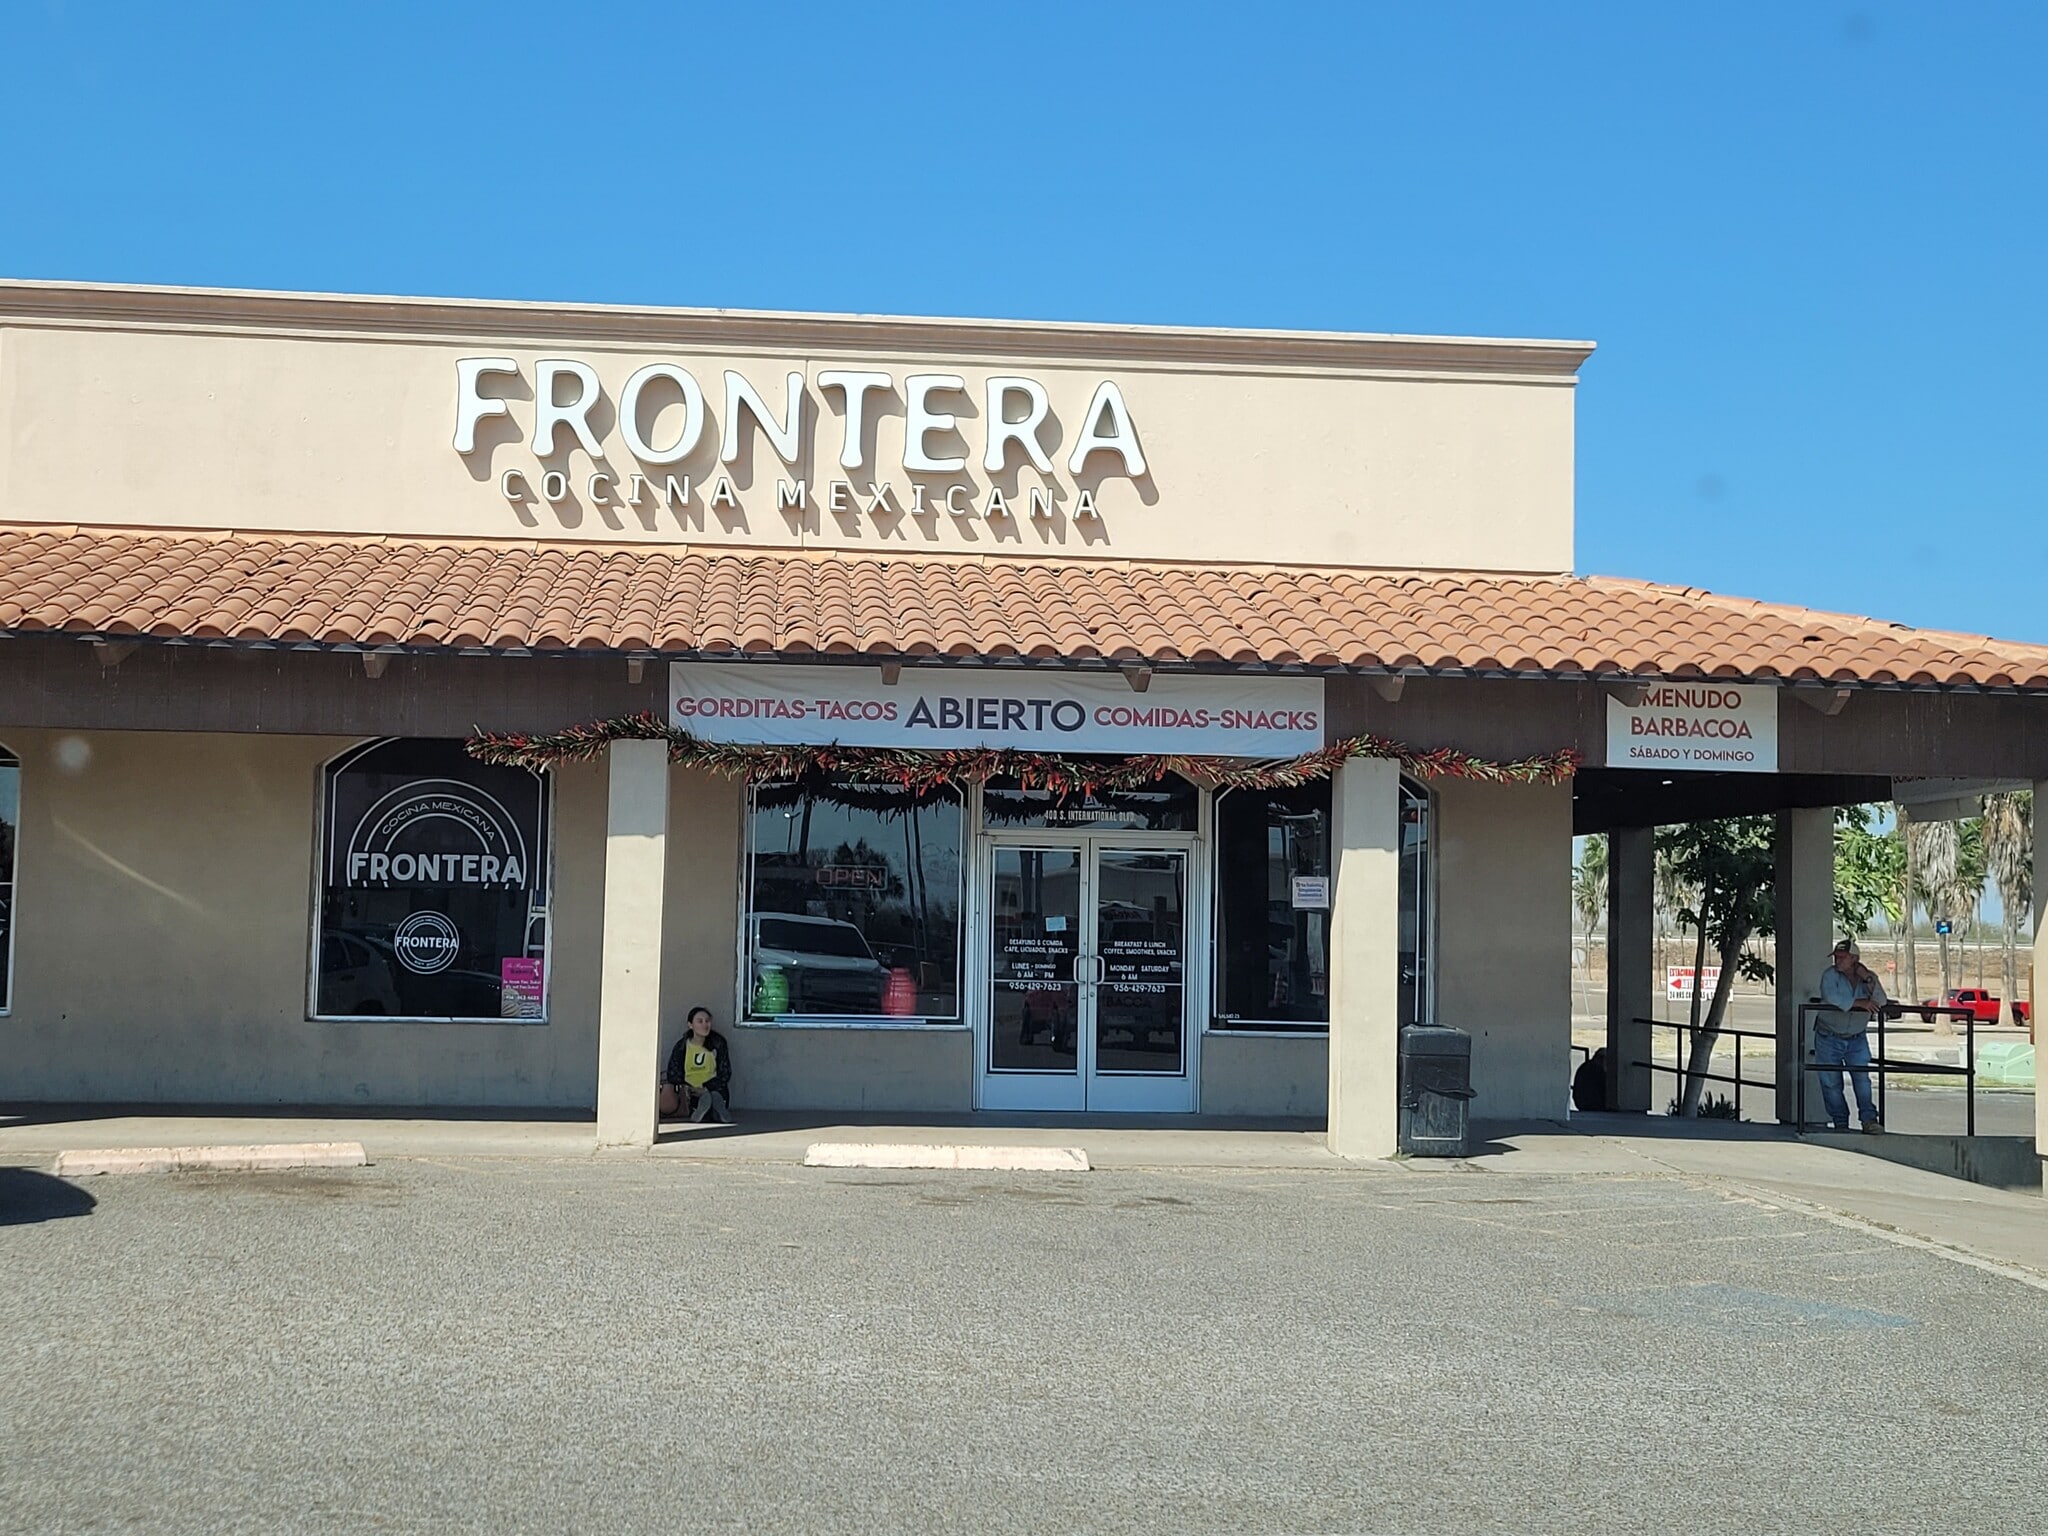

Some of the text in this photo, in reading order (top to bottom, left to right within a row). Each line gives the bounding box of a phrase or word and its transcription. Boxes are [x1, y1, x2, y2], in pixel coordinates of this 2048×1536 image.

[453, 358, 1147, 479] FRONTERA
[501, 469, 1099, 520] COCINA MEXICANA
[1642, 687, 1742, 710] MENUDO
[676, 695, 1318, 732] GORDITAS-TACOS ABIERTO COMIDAS-SNACKS
[1631, 716, 1752, 739] BARBACOA
[1629, 745, 1755, 762] SÁBADO Y DOMINGO
[382, 802, 495, 841] COCINA MEXICANA
[1068, 810, 1117, 822] INTERNATIONAL
[351, 852, 523, 884] FRONTERA
[816, 868, 882, 887] OPEN
[396, 936, 459, 950] FRONTERA
[1114, 940, 1143, 948] BREAKFAST
[1011, 961, 1030, 970] LUNES
[1109, 964, 1169, 973] MONDAY SATURDAY
[1009, 983, 1061, 991] 956-429-7623
[1113, 983, 1166, 993] 956-429-7623
